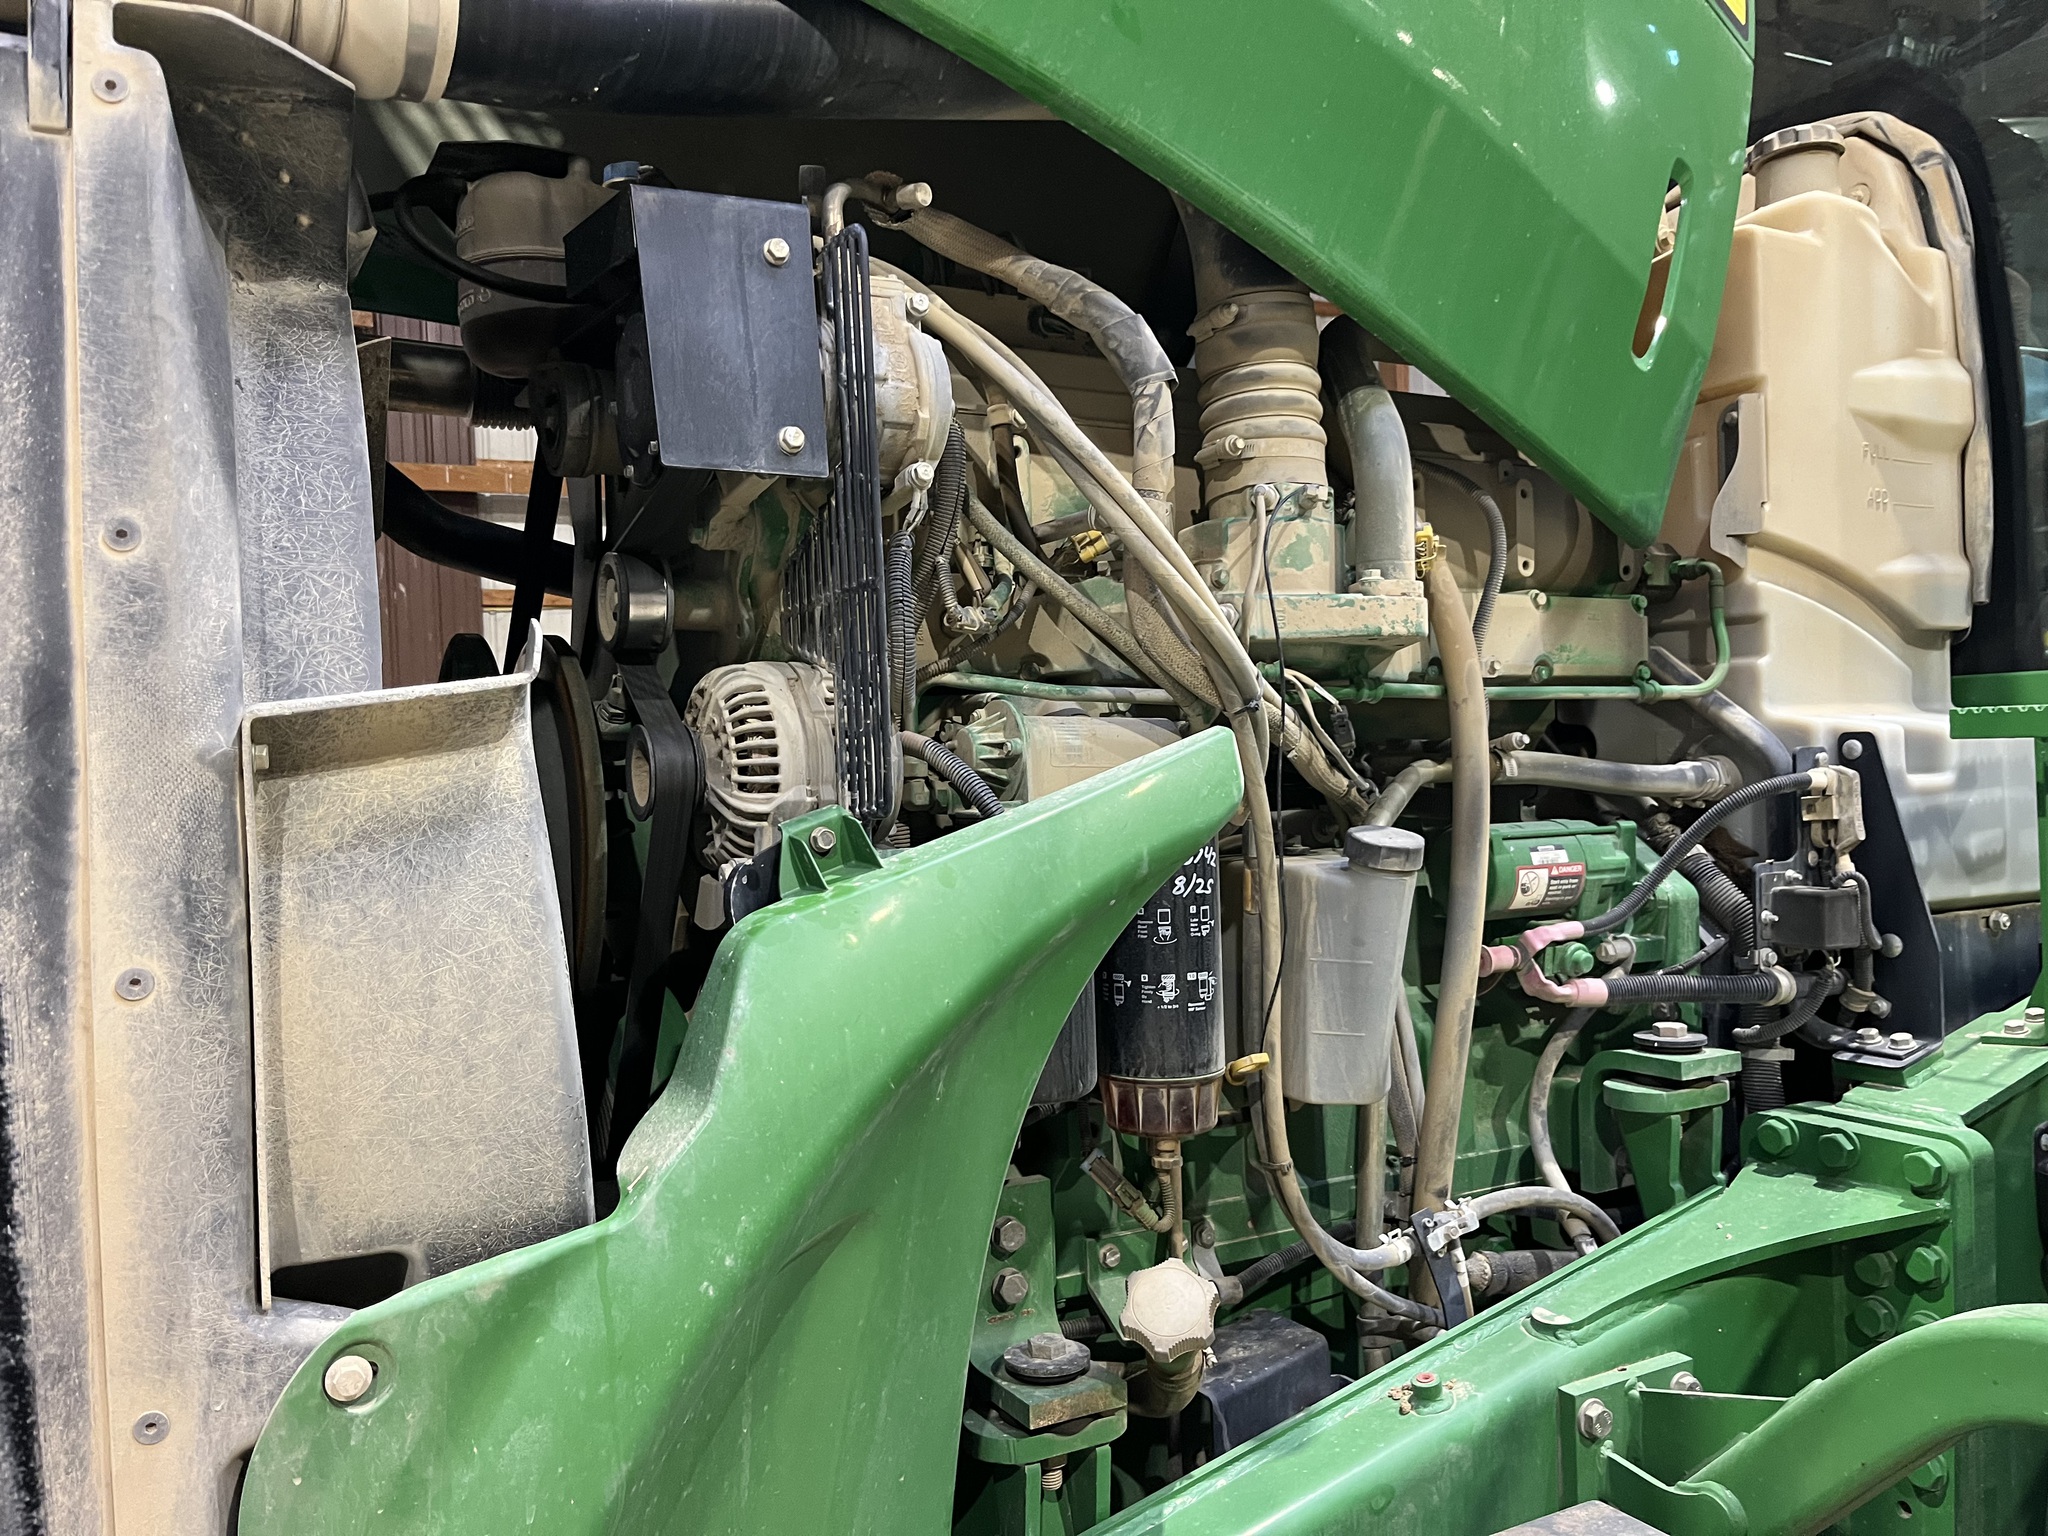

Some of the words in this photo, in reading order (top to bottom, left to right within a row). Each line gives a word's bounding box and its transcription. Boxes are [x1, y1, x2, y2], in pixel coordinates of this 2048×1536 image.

[1862, 441, 1890, 461] FULL
[1867, 487, 1889, 505] ADD
[1559, 865, 1582, 873] DANGER
[1172, 873, 1214, 897] 8/25
